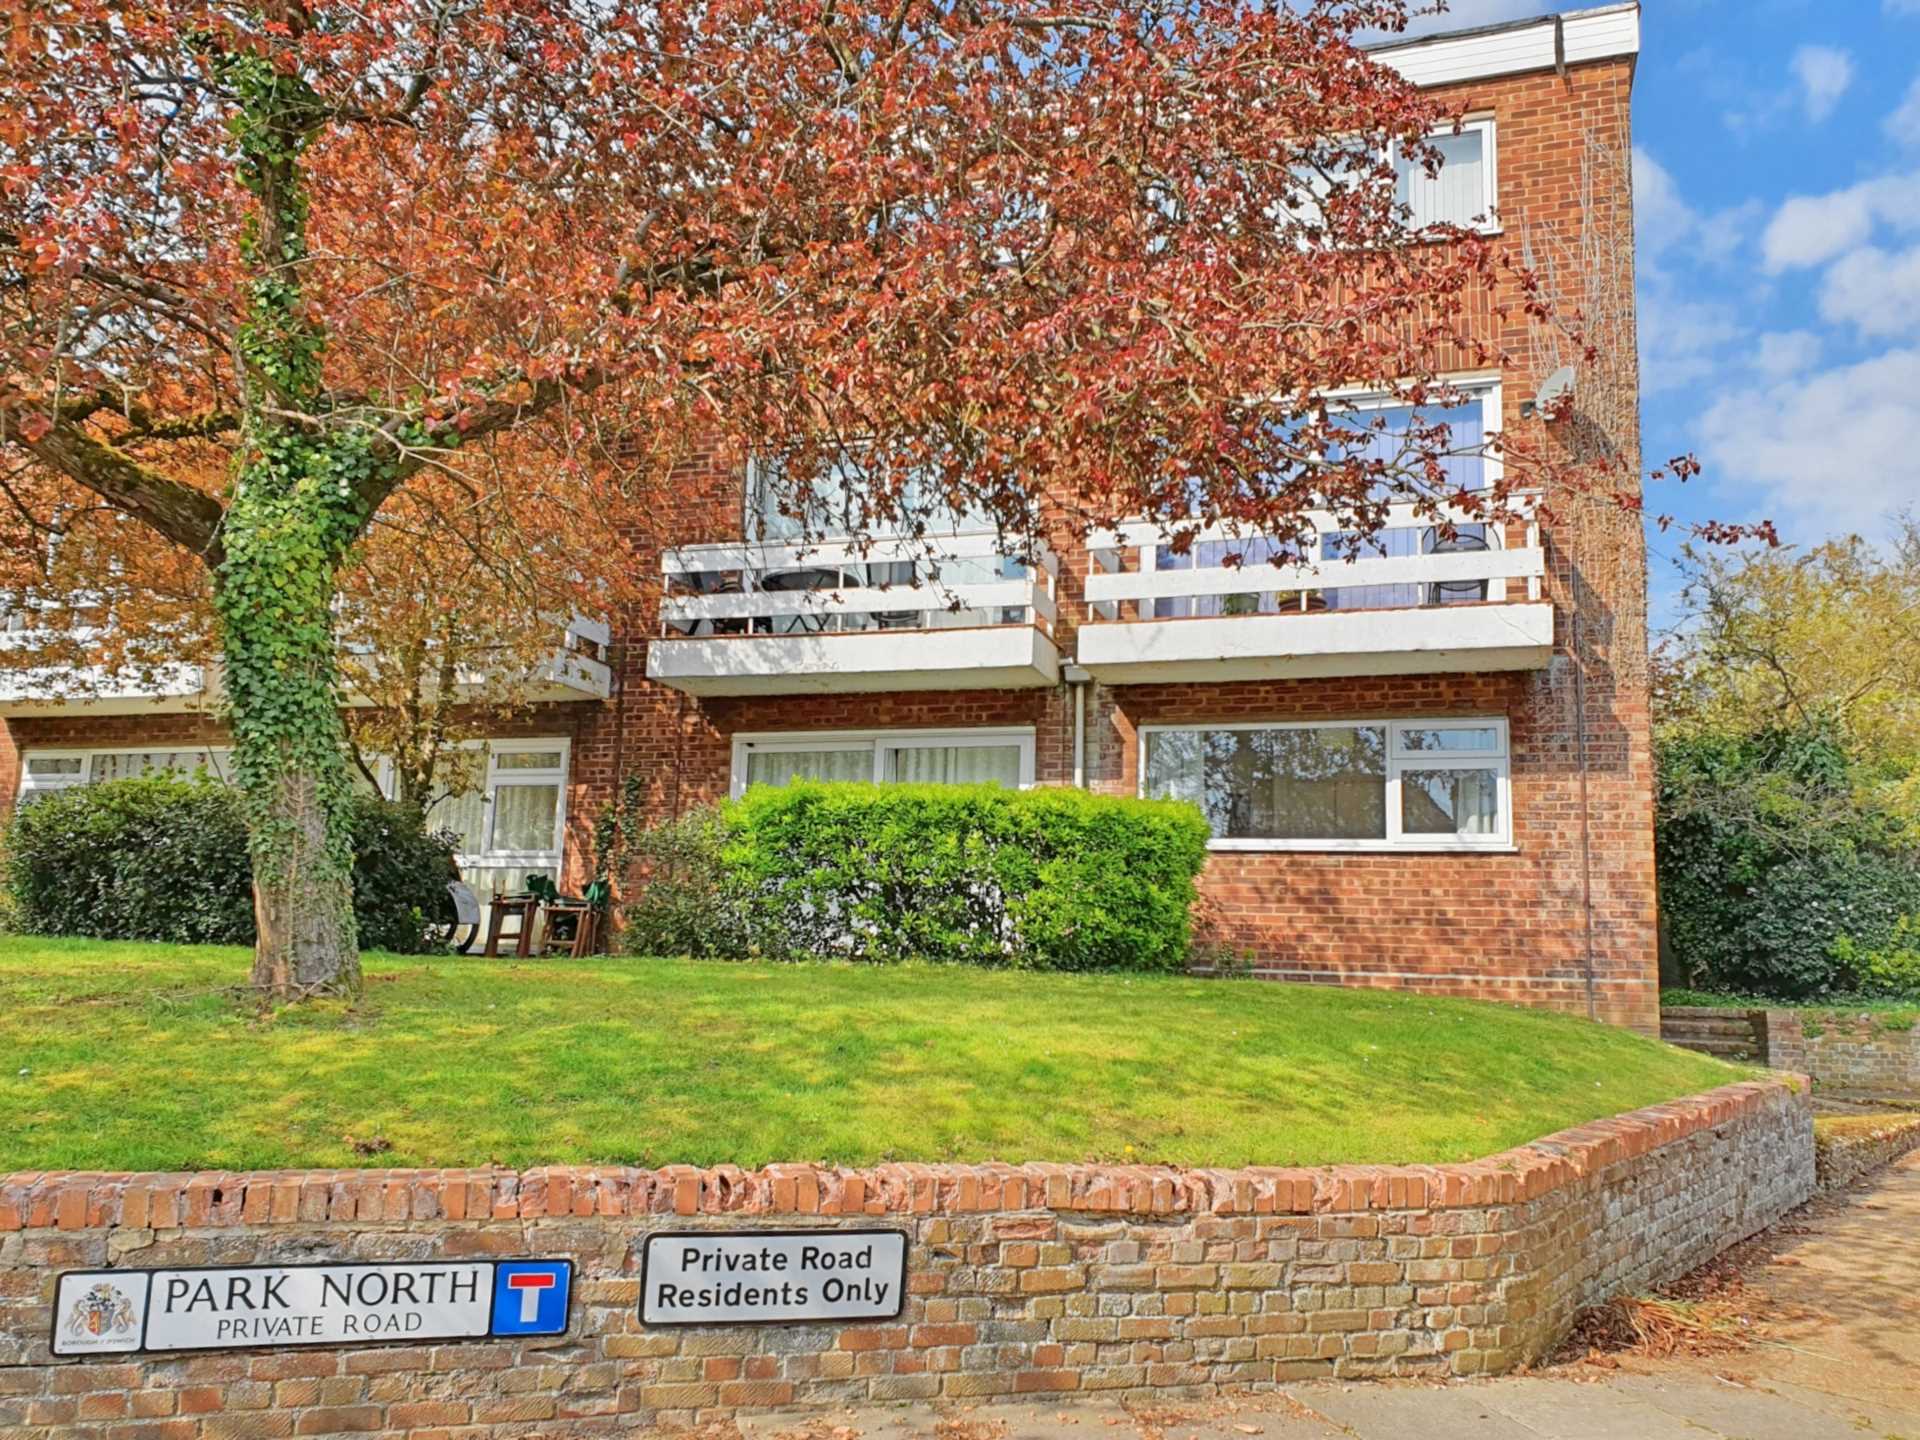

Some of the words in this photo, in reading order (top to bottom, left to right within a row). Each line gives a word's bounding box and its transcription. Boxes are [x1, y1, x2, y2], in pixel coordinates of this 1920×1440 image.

[681, 1248, 788, 1272] Private
[801, 1245, 872, 1270] Road
[166, 1274, 291, 1312] PARK
[321, 1271, 478, 1307] NORTH
[657, 1282, 809, 1308] Residents
[822, 1277, 889, 1305] Only
[217, 1316, 324, 1338] PRIVATE
[343, 1313, 422, 1333] ROAD
